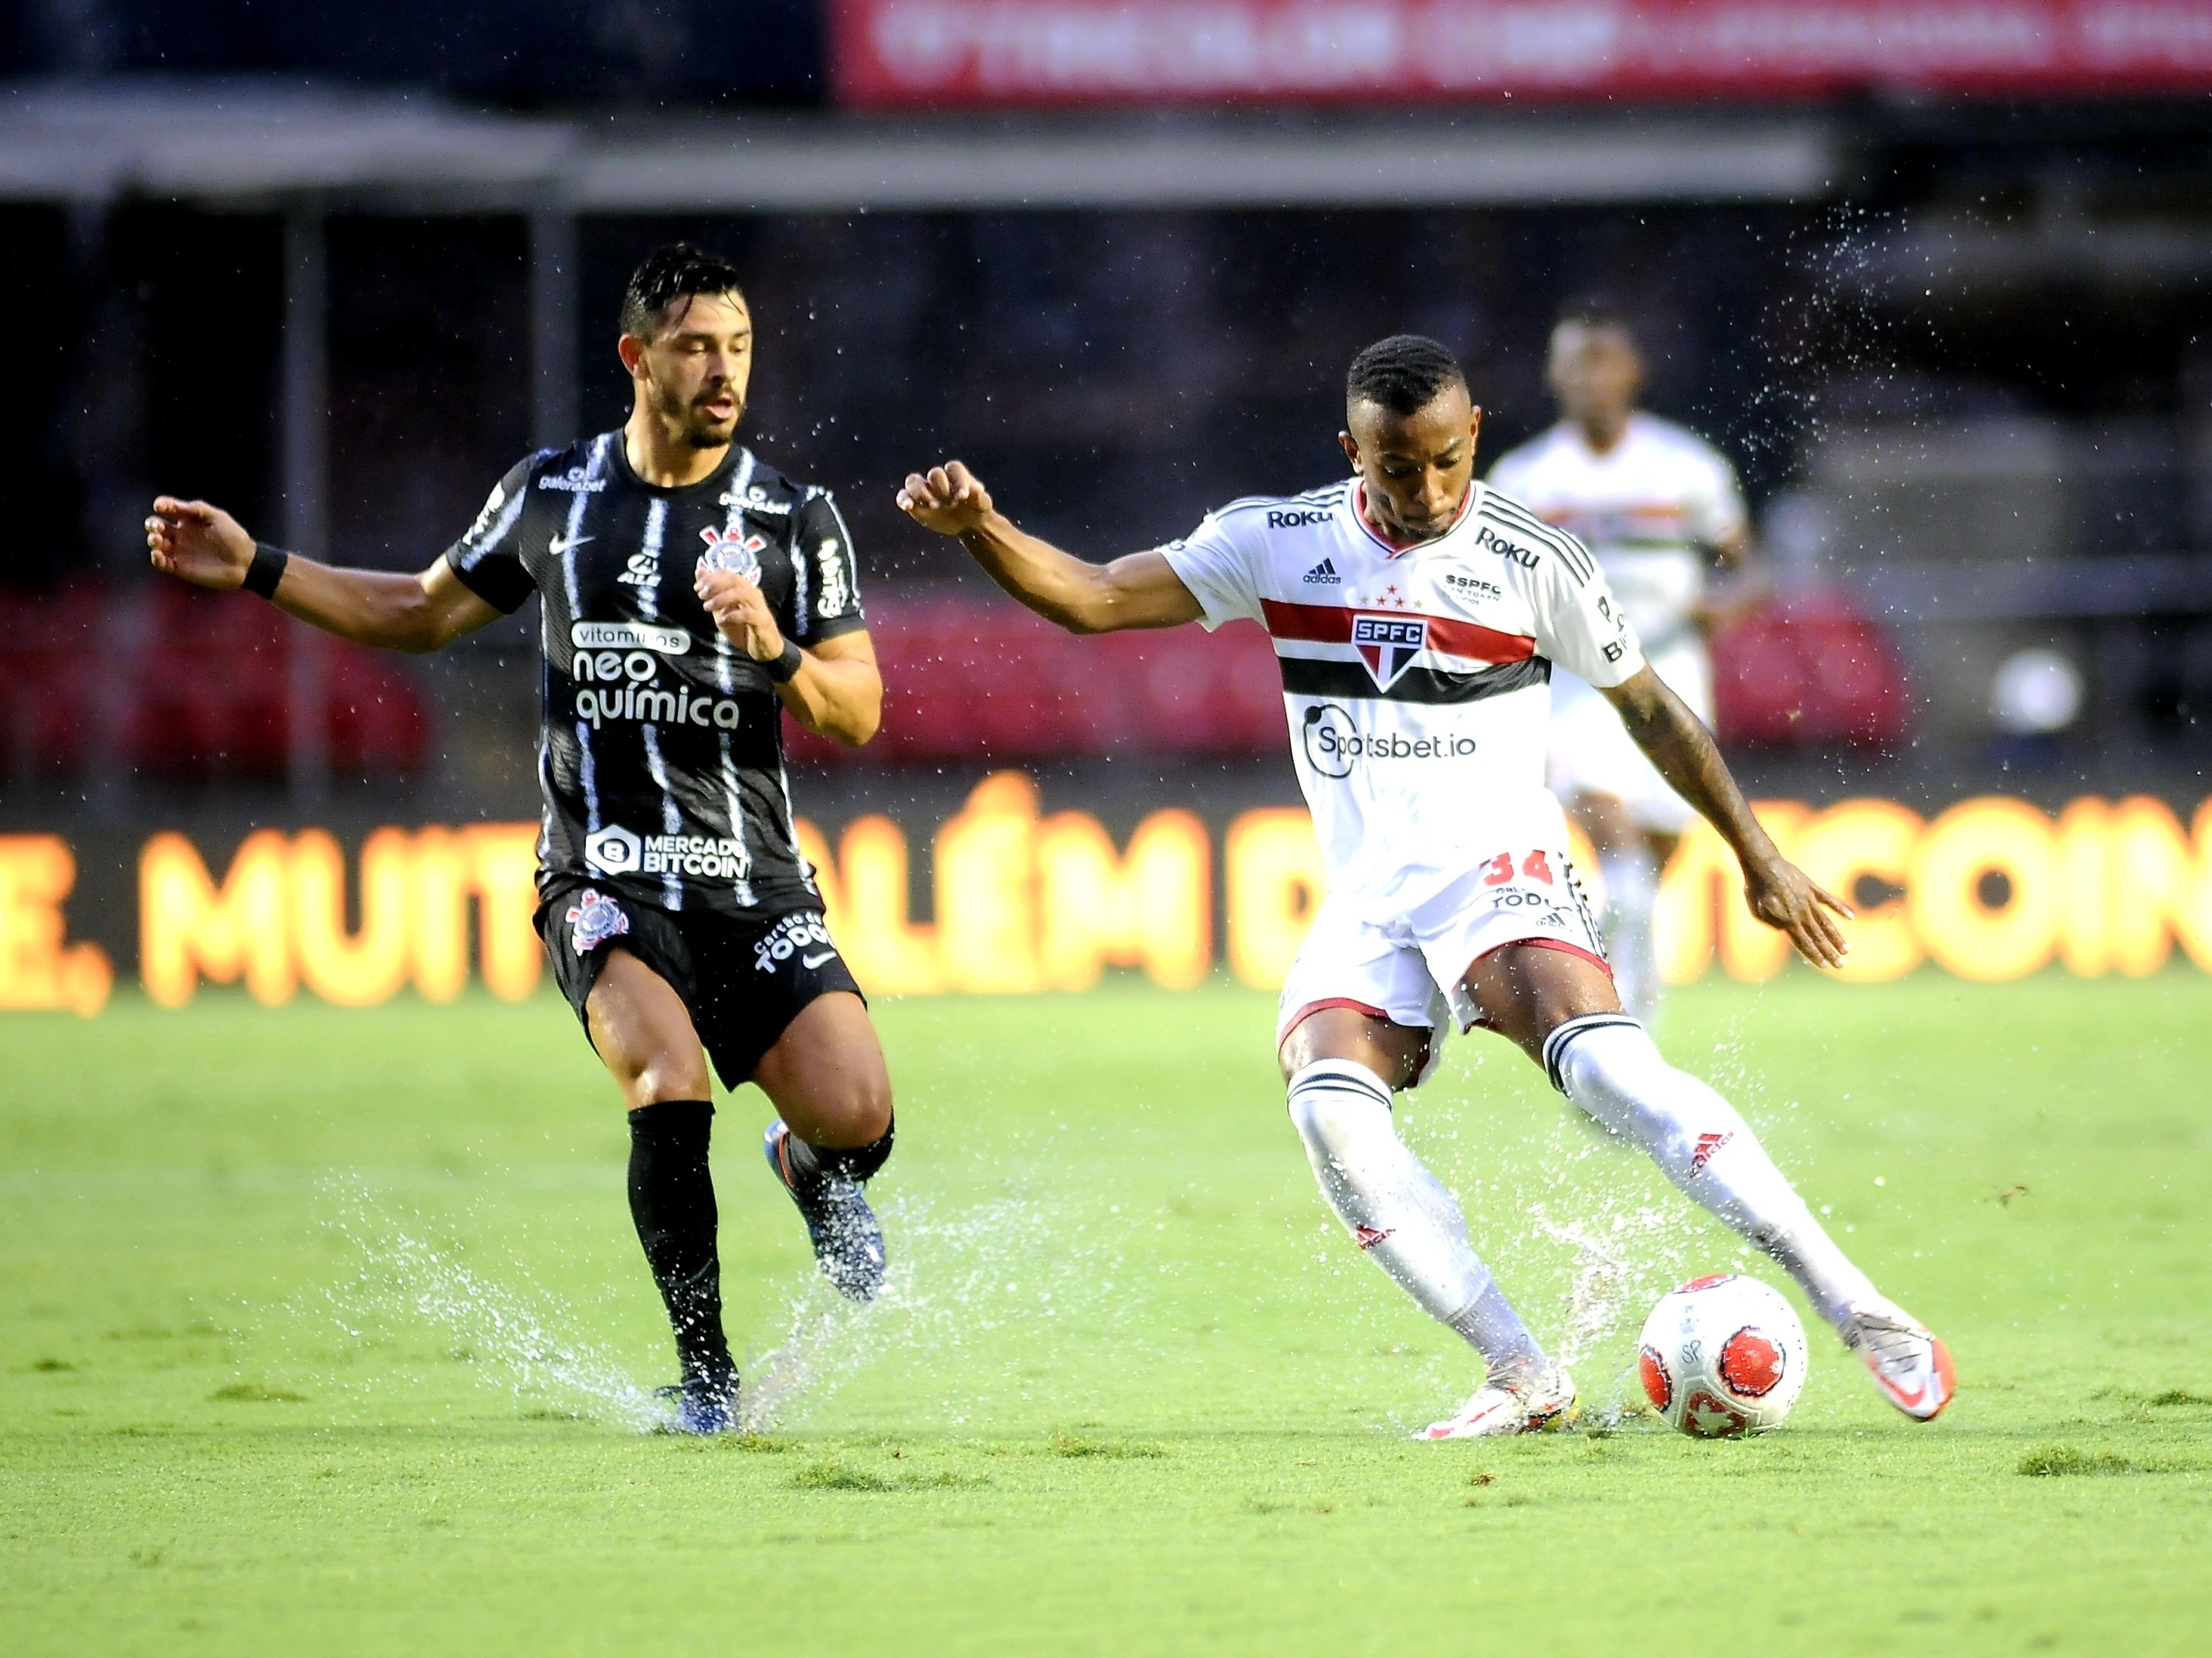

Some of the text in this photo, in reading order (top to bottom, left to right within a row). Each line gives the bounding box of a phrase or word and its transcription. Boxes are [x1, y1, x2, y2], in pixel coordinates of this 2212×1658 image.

[1303, 573, 1341, 584] adidas
[580, 627, 680, 648] vitamias
[1357, 622, 1421, 642] SPFC
[574, 650, 656, 682] neo
[576, 681, 740, 730] química
[1318, 726, 1476, 762] Spotsbet.io
[645, 834, 747, 859] MERCADO
[643, 852, 747, 879] BITCOIN
[1480, 849, 1553, 886] 34
[139, 821, 542, 1007] MUIT
